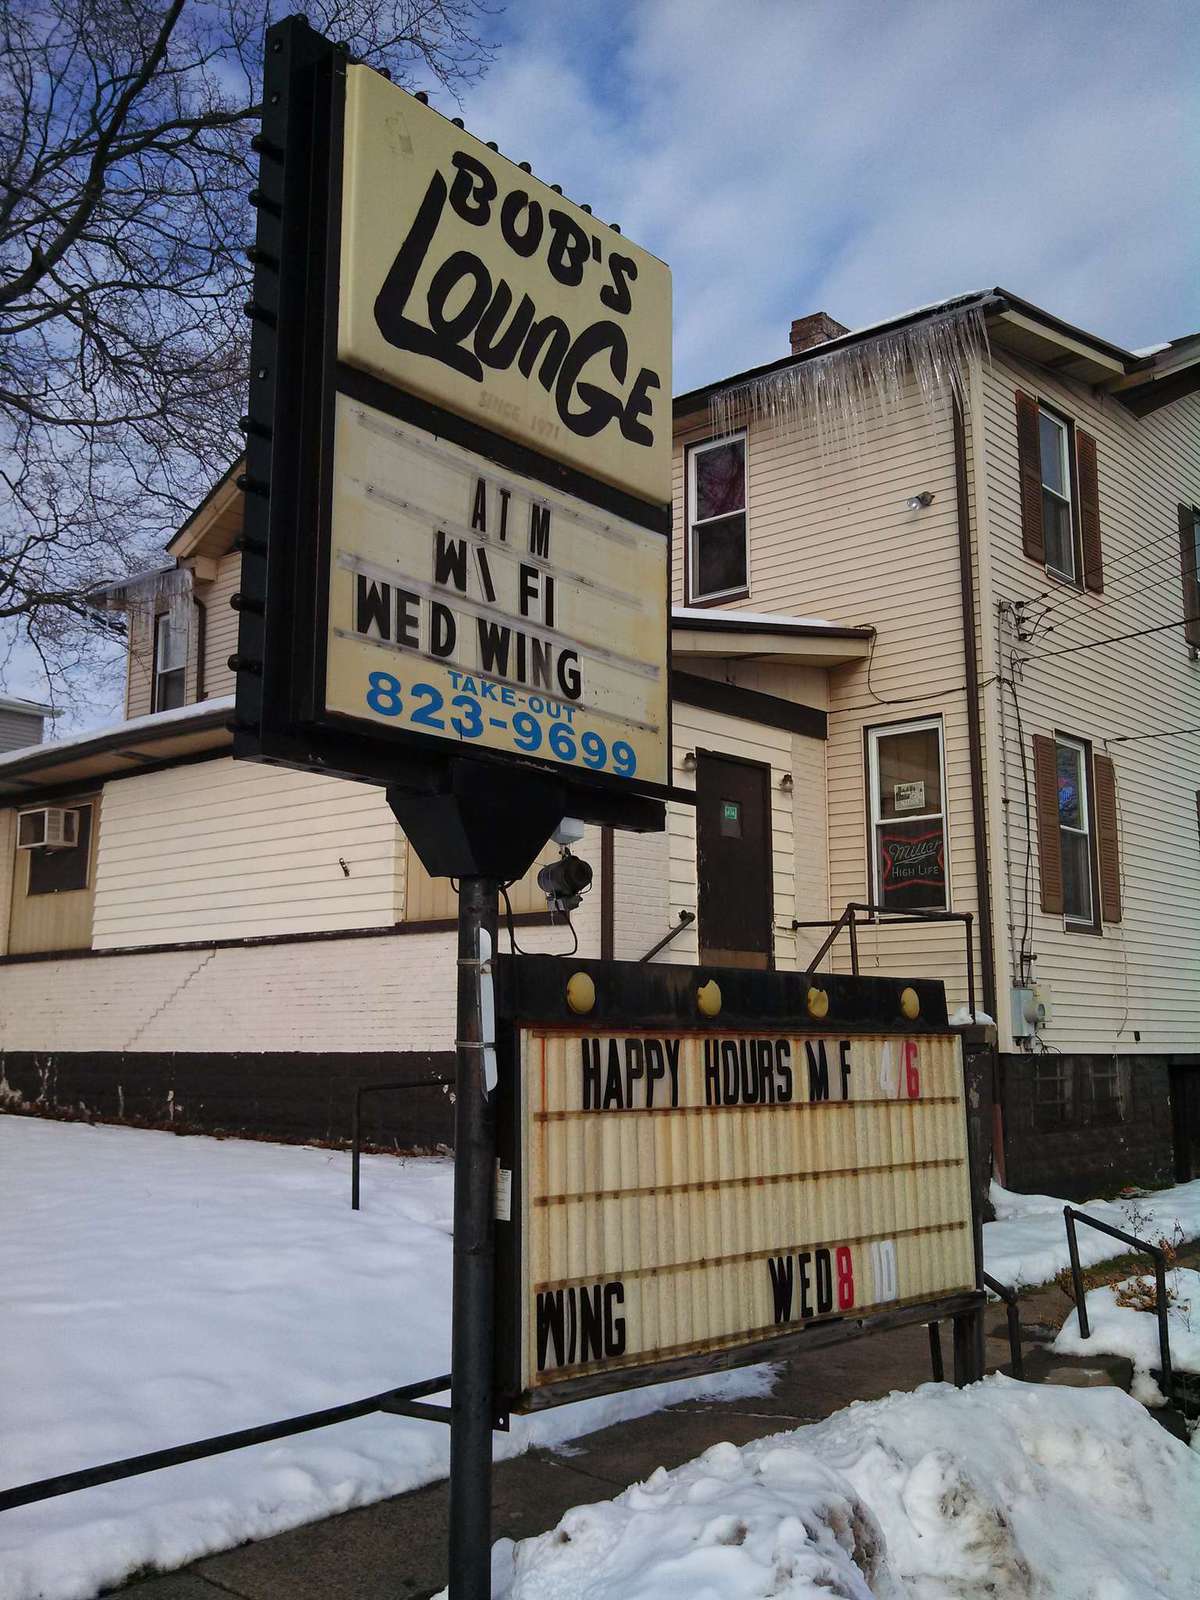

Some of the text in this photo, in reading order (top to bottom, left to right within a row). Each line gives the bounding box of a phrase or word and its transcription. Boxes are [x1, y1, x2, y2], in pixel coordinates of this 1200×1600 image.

[449, 151, 638, 315] BOB'S
[471, 478, 551, 559] ATM
[357, 574, 582, 700] WED WING
[520, 563, 554, 628] FI
[366, 671, 637, 778] 823-9699
[447, 670, 577, 723] TAKE-OUT
[581, 1038, 680, 1110] HAPPY
[704, 1039, 793, 1106] HOURS
[904, 1040, 920, 1099] 6
[536, 1281, 626, 1371] WING
[768, 1248, 833, 1323] WED
[836, 1246, 855, 1311] 8
